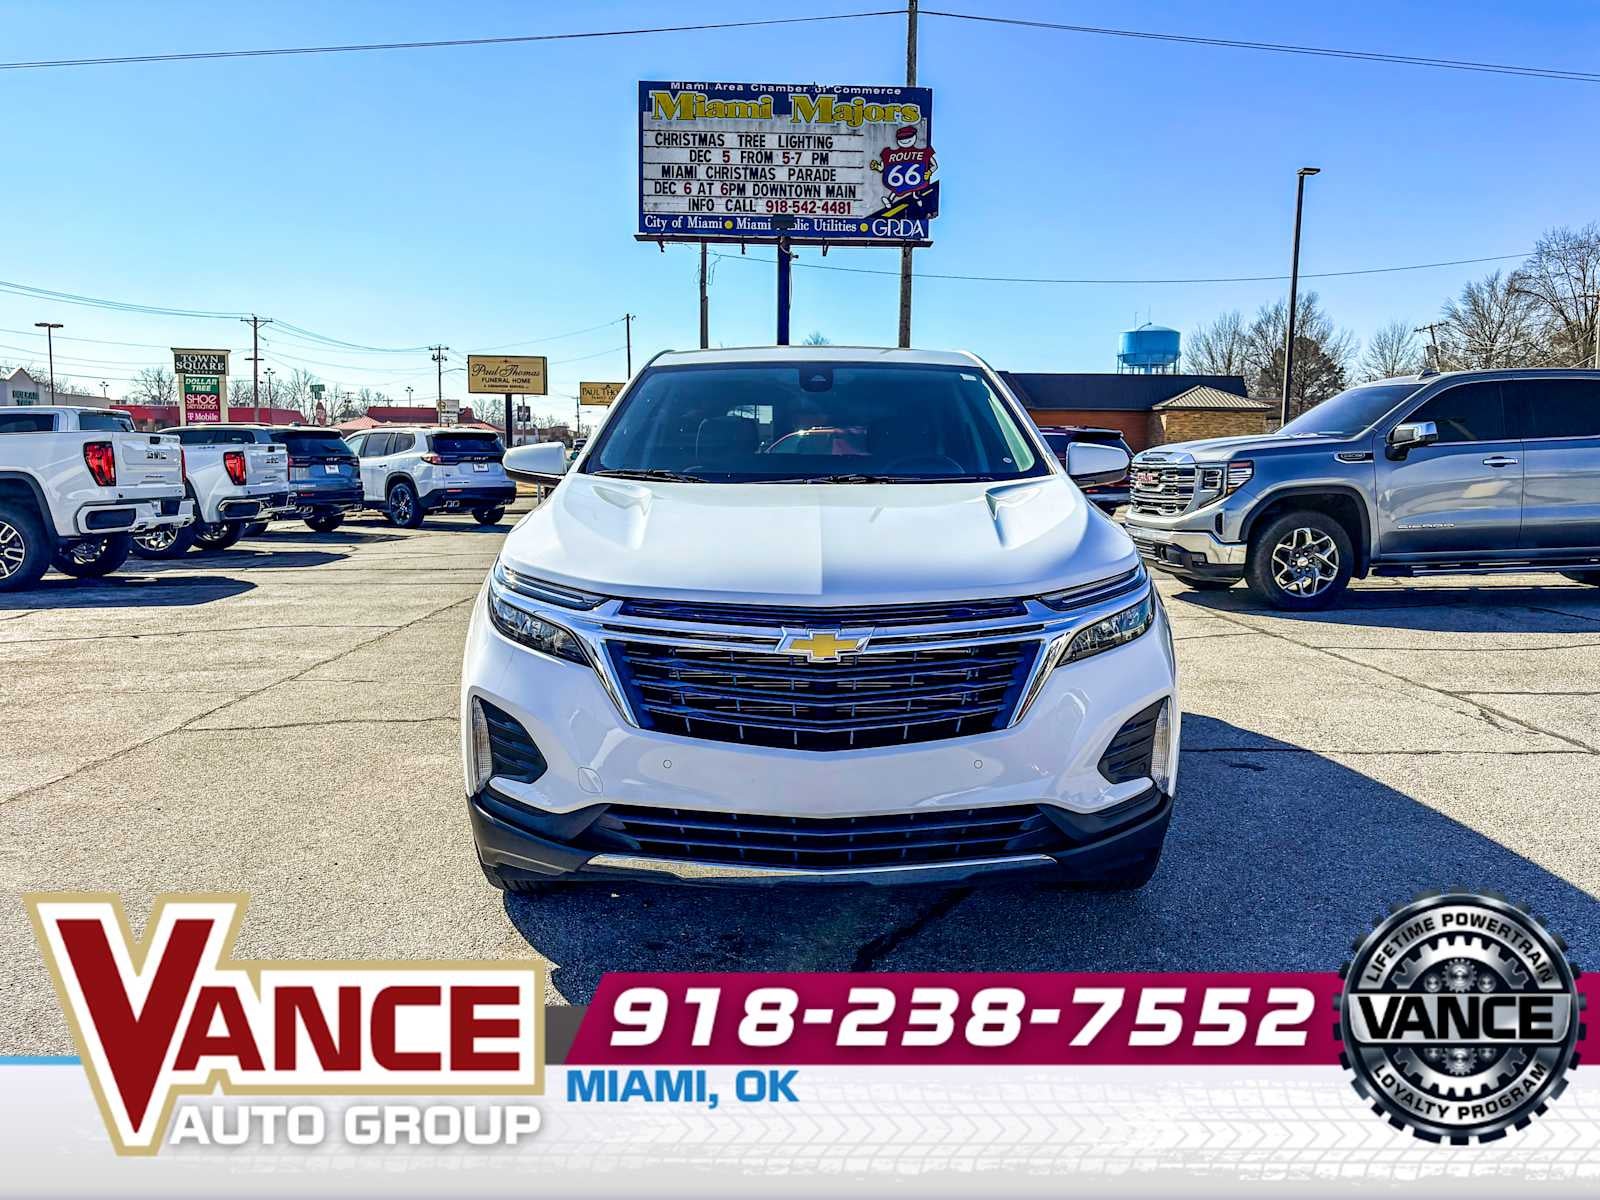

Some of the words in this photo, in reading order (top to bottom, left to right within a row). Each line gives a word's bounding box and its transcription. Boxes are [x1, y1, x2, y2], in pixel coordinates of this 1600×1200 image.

[670, 82, 708, 90] Miami
[714, 83, 744, 91] Area
[750, 84, 808, 93] Chamber
[833, 86, 901, 95] Commerce
[649, 90, 774, 121] Miami
[789, 94, 921, 129] Majors
[655, 132, 725, 147] CHRISTMAS
[737, 134, 766, 148] TREE
[777, 135, 833, 149] LIGHTING
[689, 149, 712, 163] DEC
[722, 150, 731, 164] 5
[740, 151, 773, 164] FROM
[782, 151, 802, 165] 5-7
[812, 152, 829, 166] PM
[888, 151, 924, 163] ROUTE
[661, 165, 697, 179] MIAMI
[705, 166, 776, 180] CHRISTMAS
[788, 168, 836, 182] PARADE
[887, 163, 921, 187] 66
[654, 181, 677, 195] DEC
[684, 182, 692, 195] 6
[697, 182, 714, 196] AT
[720, 183, 746, 196] 6PM
[752, 183, 822, 198] DOWNTOWN
[825, 185, 857, 199] MAIN
[688, 198, 714, 212] INFO
[724, 199, 756, 213] CALL
[765, 200, 851, 215] 918-542-4481
[644, 214, 668, 231] City
[671, 215, 682, 228] of
[687, 215, 723, 229] Miami
[736, 216, 772, 230] Miami
[813, 219, 857, 232] Utilities
[871, 219, 925, 237] GRDA
[175, 361, 225, 371] SQUARE
[180, 354, 219, 363] TOWN
[471, 363, 501, 377] Paul
[499, 364, 540, 378] Thomas
